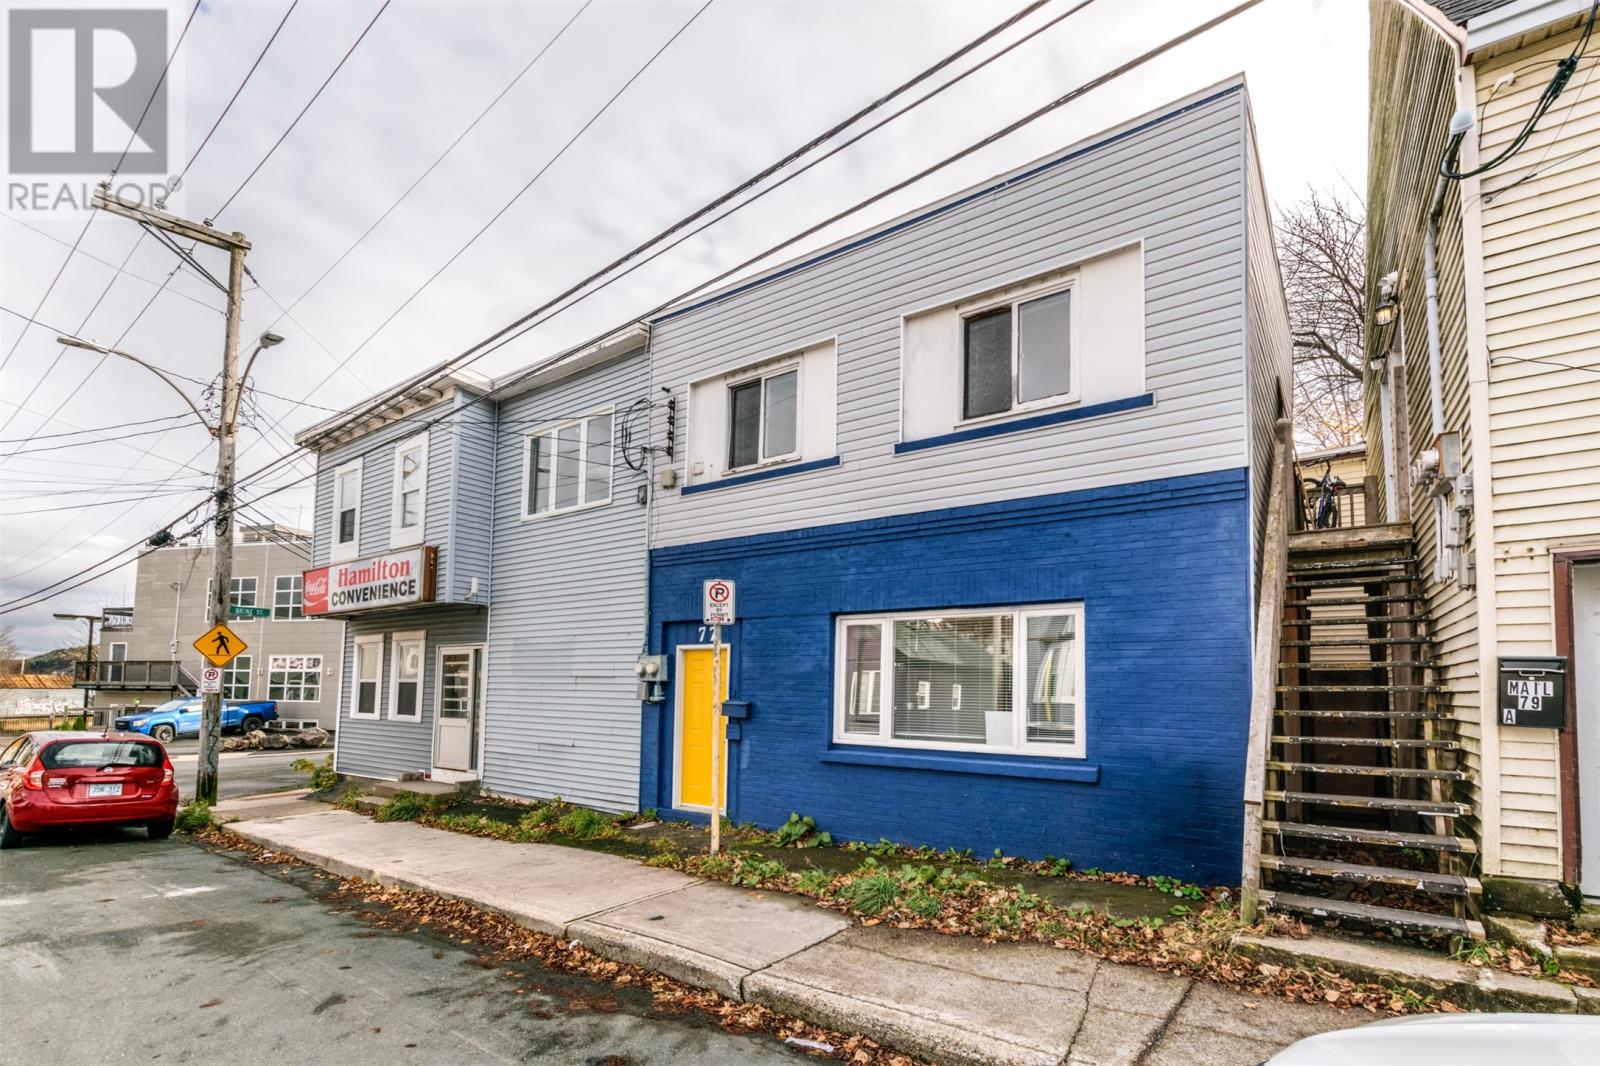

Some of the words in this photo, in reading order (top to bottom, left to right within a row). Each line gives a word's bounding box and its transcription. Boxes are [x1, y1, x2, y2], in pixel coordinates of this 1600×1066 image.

[338, 559, 410, 588] Hamilton
[331, 579, 416, 607] CONVENIENCE
[1509, 681, 1551, 696] MAIL
[1520, 696, 1540, 710] 79
[1505, 710, 1514, 723] A
